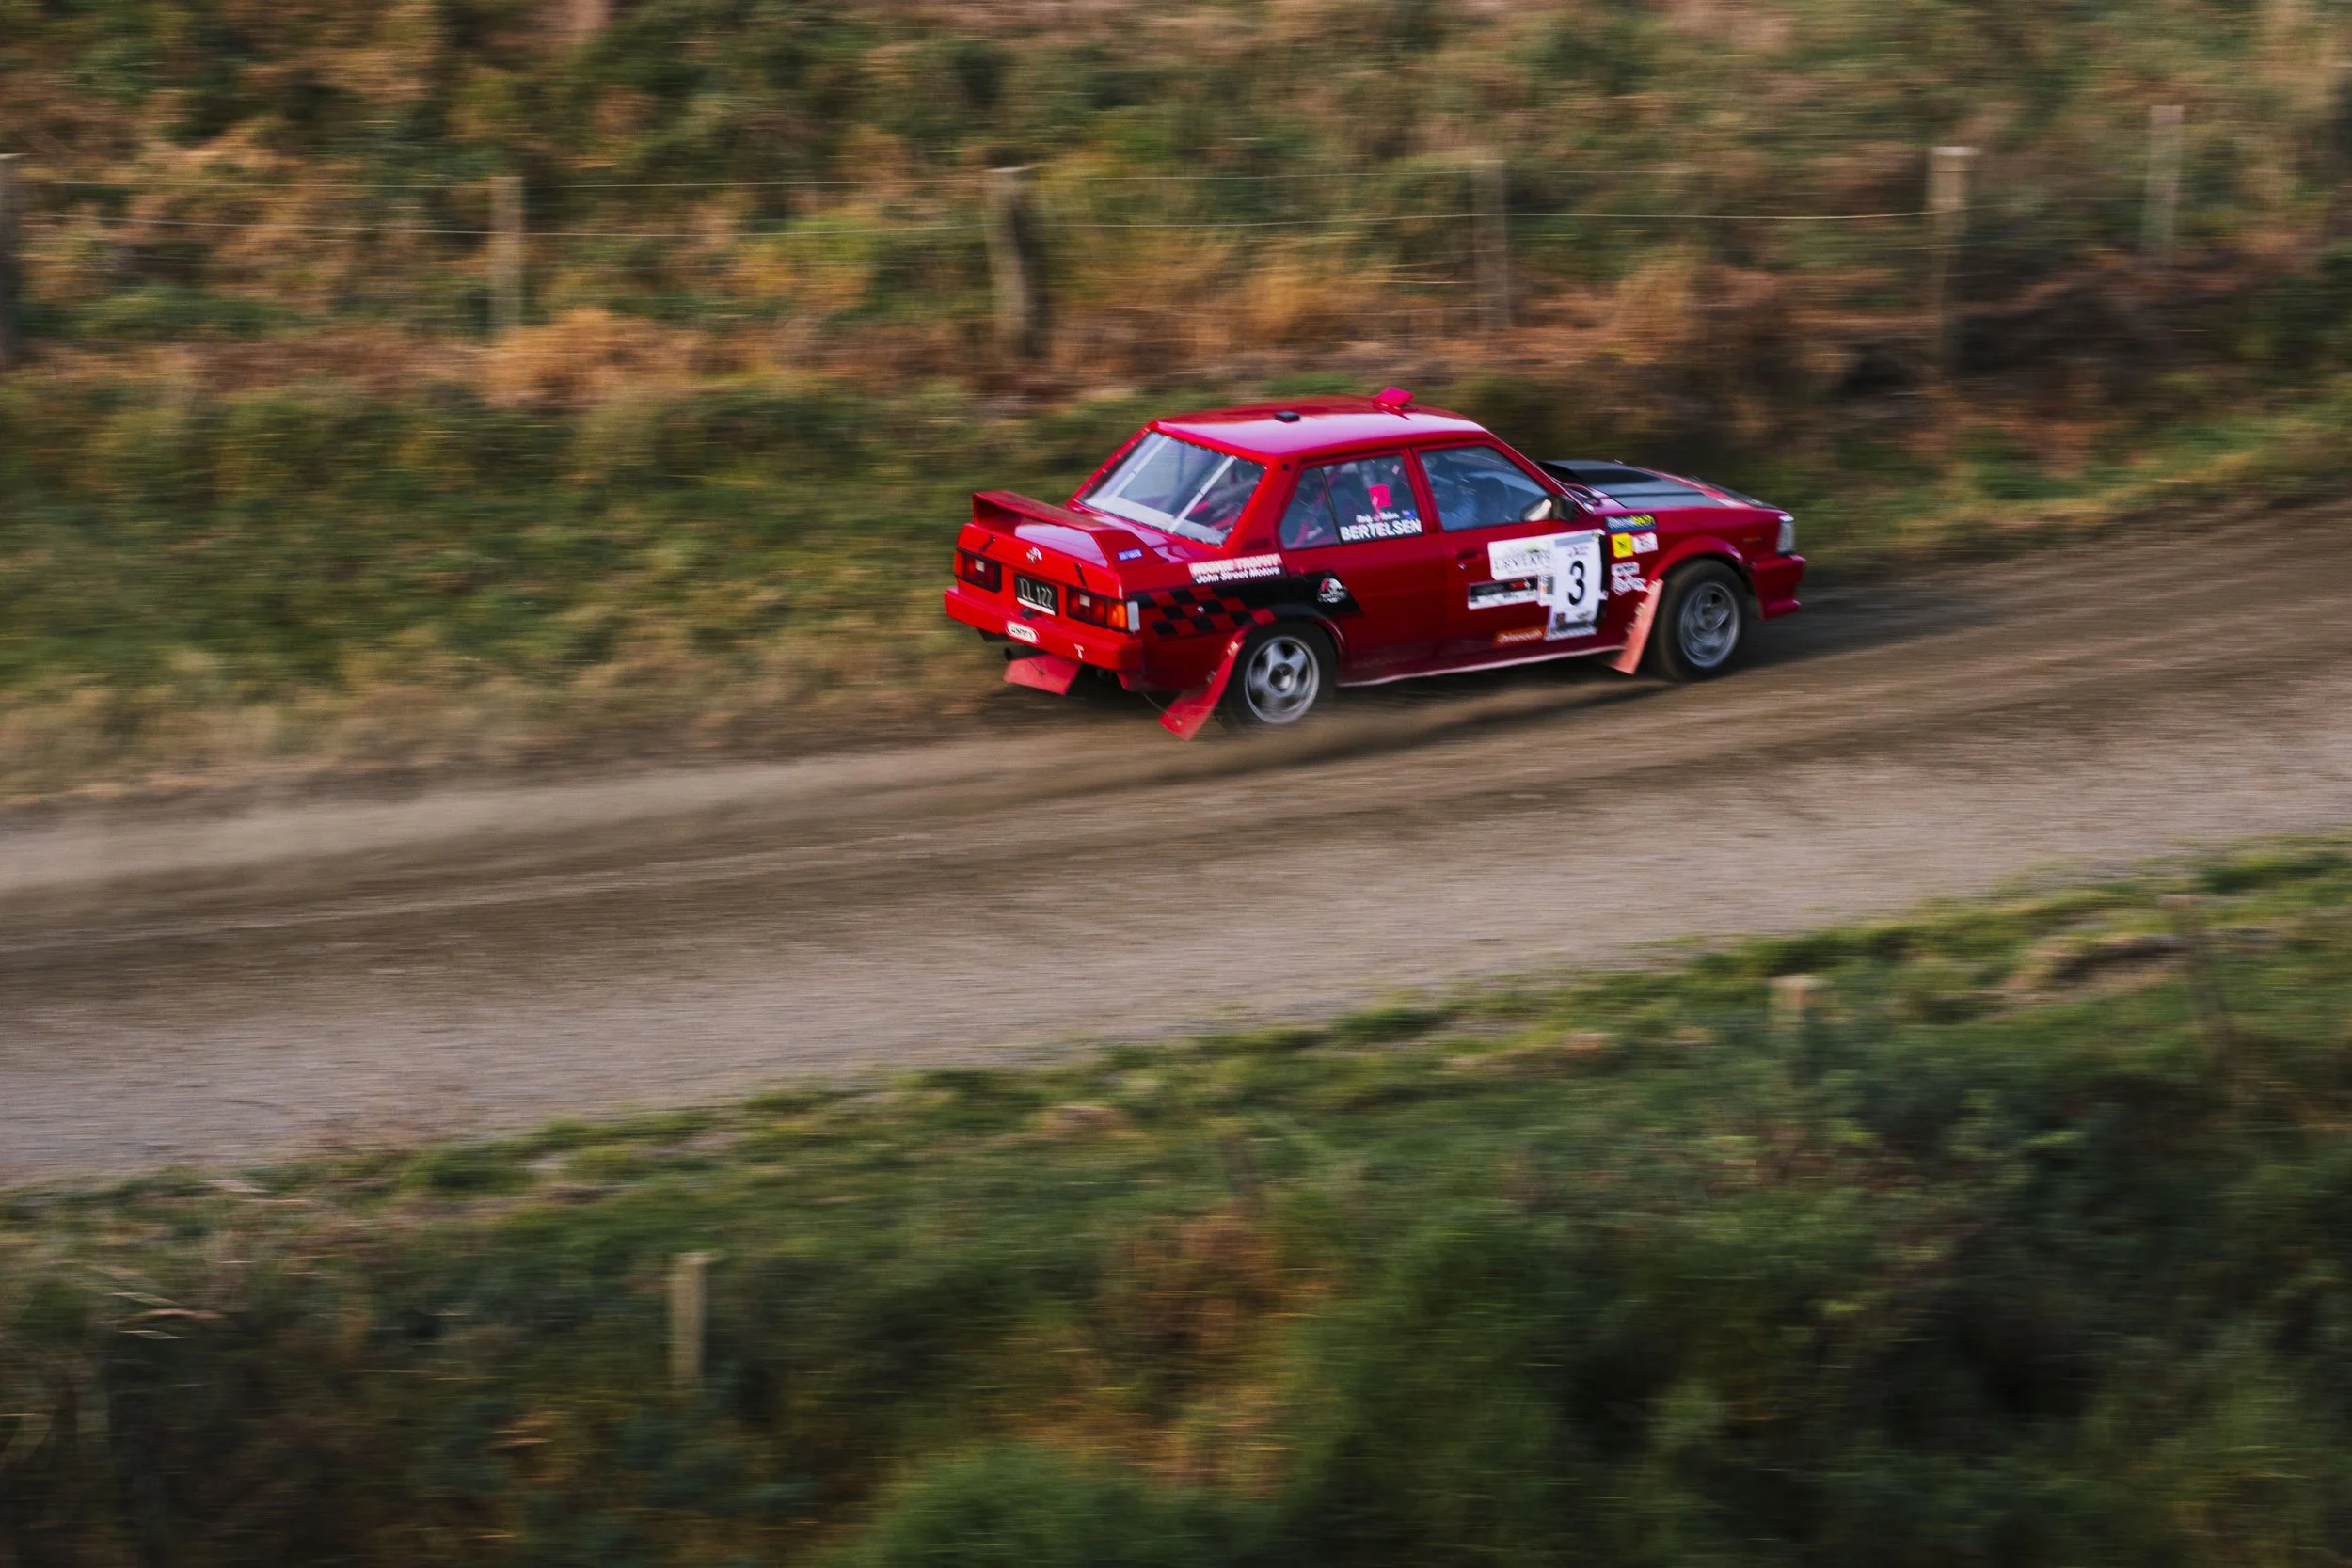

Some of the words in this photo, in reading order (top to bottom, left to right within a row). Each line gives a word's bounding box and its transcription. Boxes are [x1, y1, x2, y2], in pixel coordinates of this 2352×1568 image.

[1340, 518, 1422, 541] BERTELSEN
[1196, 572, 1219, 584] John
[1220, 568, 1248, 581] Street
[1248, 566, 1280, 578] Motors
[1568, 561, 1585, 605] 3
